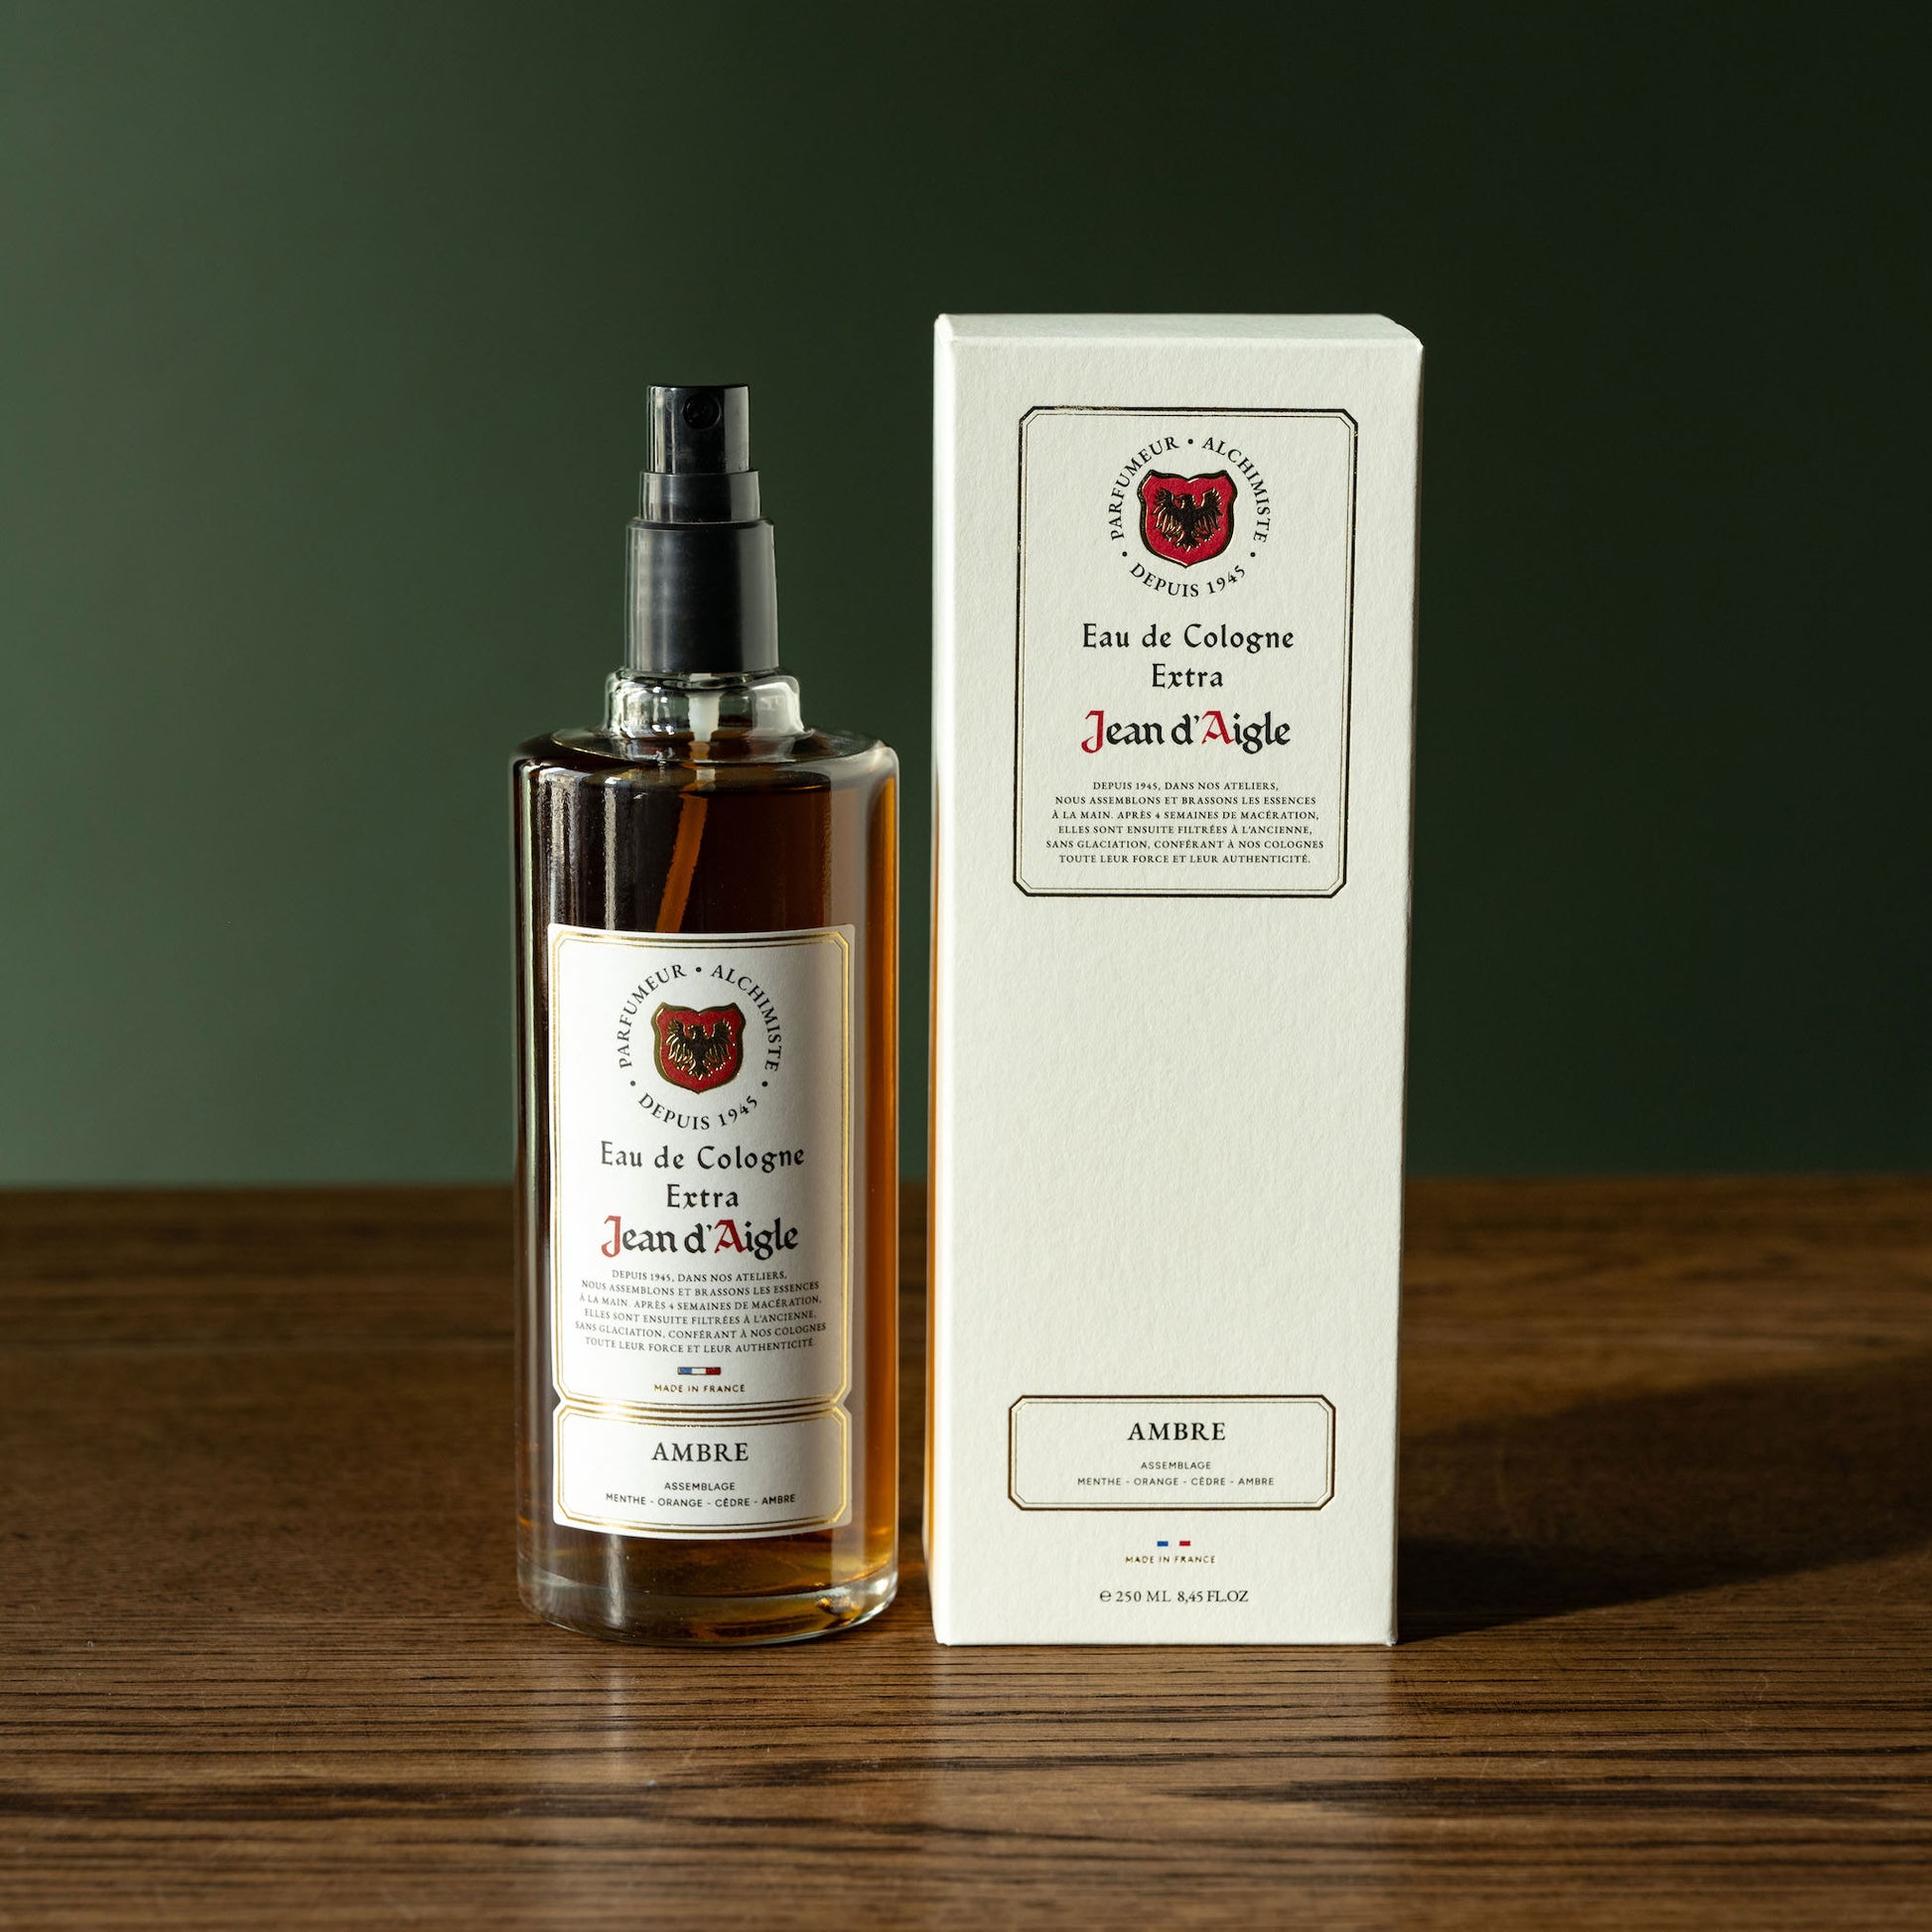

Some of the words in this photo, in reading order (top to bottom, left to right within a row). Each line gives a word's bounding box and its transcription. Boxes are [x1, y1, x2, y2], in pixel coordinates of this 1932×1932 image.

[1108, 436, 1179, 540] PARFUMEUR
[1201, 437, 1270, 543] ALCHIMISTE
[1130, 563, 1199, 597] DEPUIS
[1208, 565, 1245, 594] 1945
[1083, 623, 1129, 648] Eau
[1142, 625, 1171, 648] de
[1184, 624, 1294, 653] Cologne
[1152, 663, 1223, 689] Extra
[1081, 710, 1163, 753] Jean
[1224, 782, 1278, 791] ATELIERS,
[1052, 810, 1058, 819] À
[1118, 810, 1151, 819] APRÈS
[1241, 810, 1319, 820] MACÉRATION,
[1178, 825, 1227, 833] FILTRÉES
[1232, 825, 1238, 833] À
[1077, 841, 1150, 849] GLACIATION,
[1154, 840, 1223, 848] CONFÉRANT
[1228, 839, 1234, 848] À
[1223, 854, 1310, 863] AUTHENTICITÉ.
[617, 964, 687, 1069] PARFUMEUR
[711, 965, 781, 1071] ALCHIMISTE
[638, 1093, 710, 1130] DEPUIS
[718, 1095, 757, 1127] 1945
[601, 1141, 642, 1167] Eau
[654, 1146, 684, 1170] de
[697, 1145, 805, 1173] Cologne
[667, 1184, 739, 1209] Extra
[601, 1215, 677, 1257] Jean
[612, 1270, 647, 1280] DEPUIS
[678, 1274, 707, 1282] DANS
[582, 1280, 606, 1290] NOUS
[610, 1284, 674, 1296] ASSEMBLONS
[753, 1286, 770, 1295] LES
[774, 1282, 819, 1293] ESSENCES
[588, 1295, 598, 1303] LA
[634, 1300, 665, 1309] APRÈS
[678, 1302, 731, 1311] SEMAINES
[585, 1308, 610, 1319] ELLES
[613, 1313, 639, 1322] SONT
[643, 1315, 687, 1324] ENSUITE
[691, 1315, 740, 1325] FILTRÉES
[744, 1315, 750, 1324] À
[575, 1321, 596, 1331] SANS
[668, 1330, 737, 1339] CONFÉRANT
[740, 1329, 746, 1338] À
[751, 1329, 771, 1337] NOS
[775, 1323, 826, 1336] COLOGNES
[585, 1337, 616, 1348] TOUTE
[619, 1341, 645, 1350] LEUR
[649, 1344, 683, 1352] FORCE
[704, 1384, 745, 1392] FRANCE
[1128, 1422, 1226, 1441] AMBRE
[651, 1443, 749, 1462] AMBRE
[1141, 1462, 1212, 1470] ASSEMBLAGE
[664, 1481, 735, 1491] ASSEMBLAGE
[1133, 1478, 1178, 1486] ORANGE
[1238, 1477, 1274, 1486] AMBRE
[606, 1493, 646, 1505] MENTHE
[657, 1498, 702, 1507] ORANGE
[761, 1494, 795, 1505] AMBRE
[1116, 1591, 1141, 1602] 250
[1146, 1590, 1171, 1602] ML
[1178, 1591, 1203, 1604] 8,45
